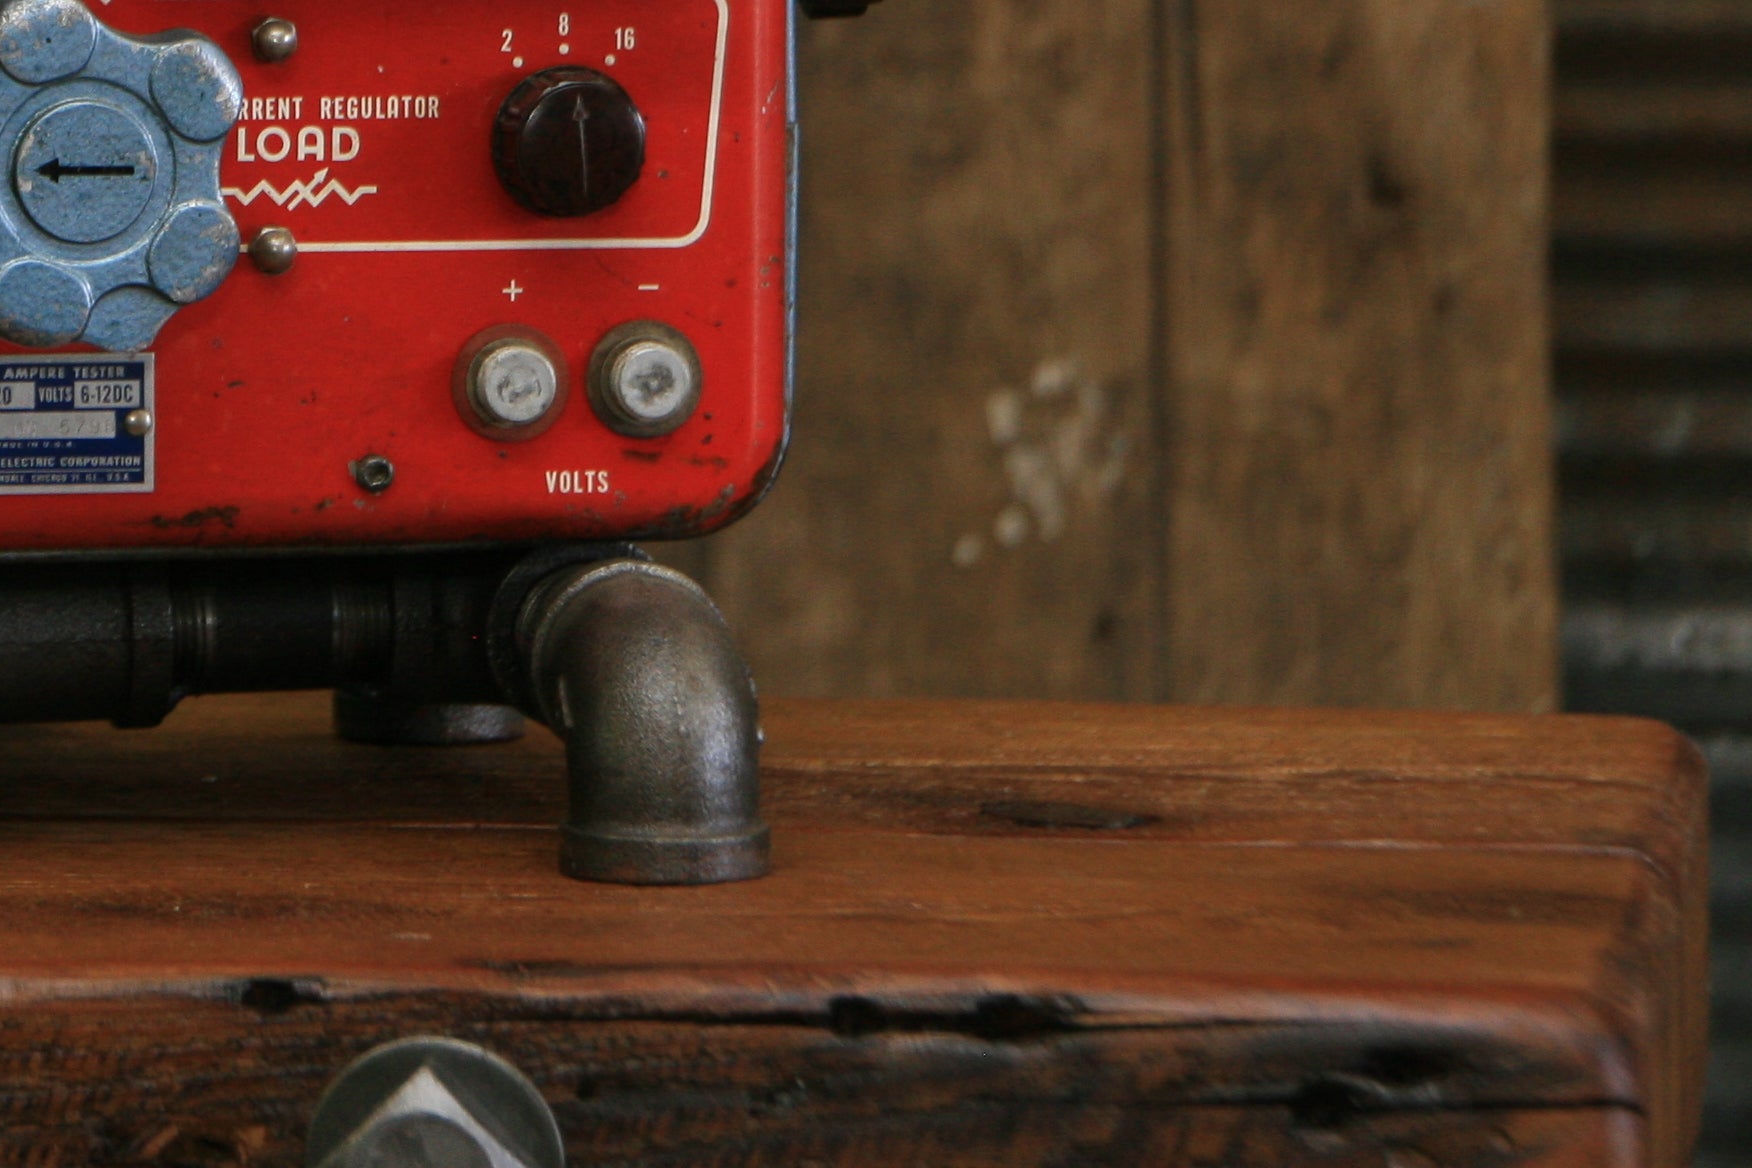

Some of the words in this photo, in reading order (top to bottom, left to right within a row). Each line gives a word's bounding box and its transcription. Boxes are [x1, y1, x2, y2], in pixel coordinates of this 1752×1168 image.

[500, 28, 513, 52] 2
[558, 12, 569, 36] 8
[614, 27, 635, 50] 16
[238, 96, 304, 120] RRENT
[320, 95, 440, 120] REGULATOR
[236, 125, 360, 162] LOAD
[3, 367, 65, 380] AMPERE
[73, 366, 125, 379] TESTER
[38, 386, 73, 403] VOLTS
[81, 384, 133, 403] 6-12DC
[0, 457, 55, 468] ELECTRIC
[60, 456, 141, 467] CORPORATION
[545, 470, 609, 494] VOLTS
